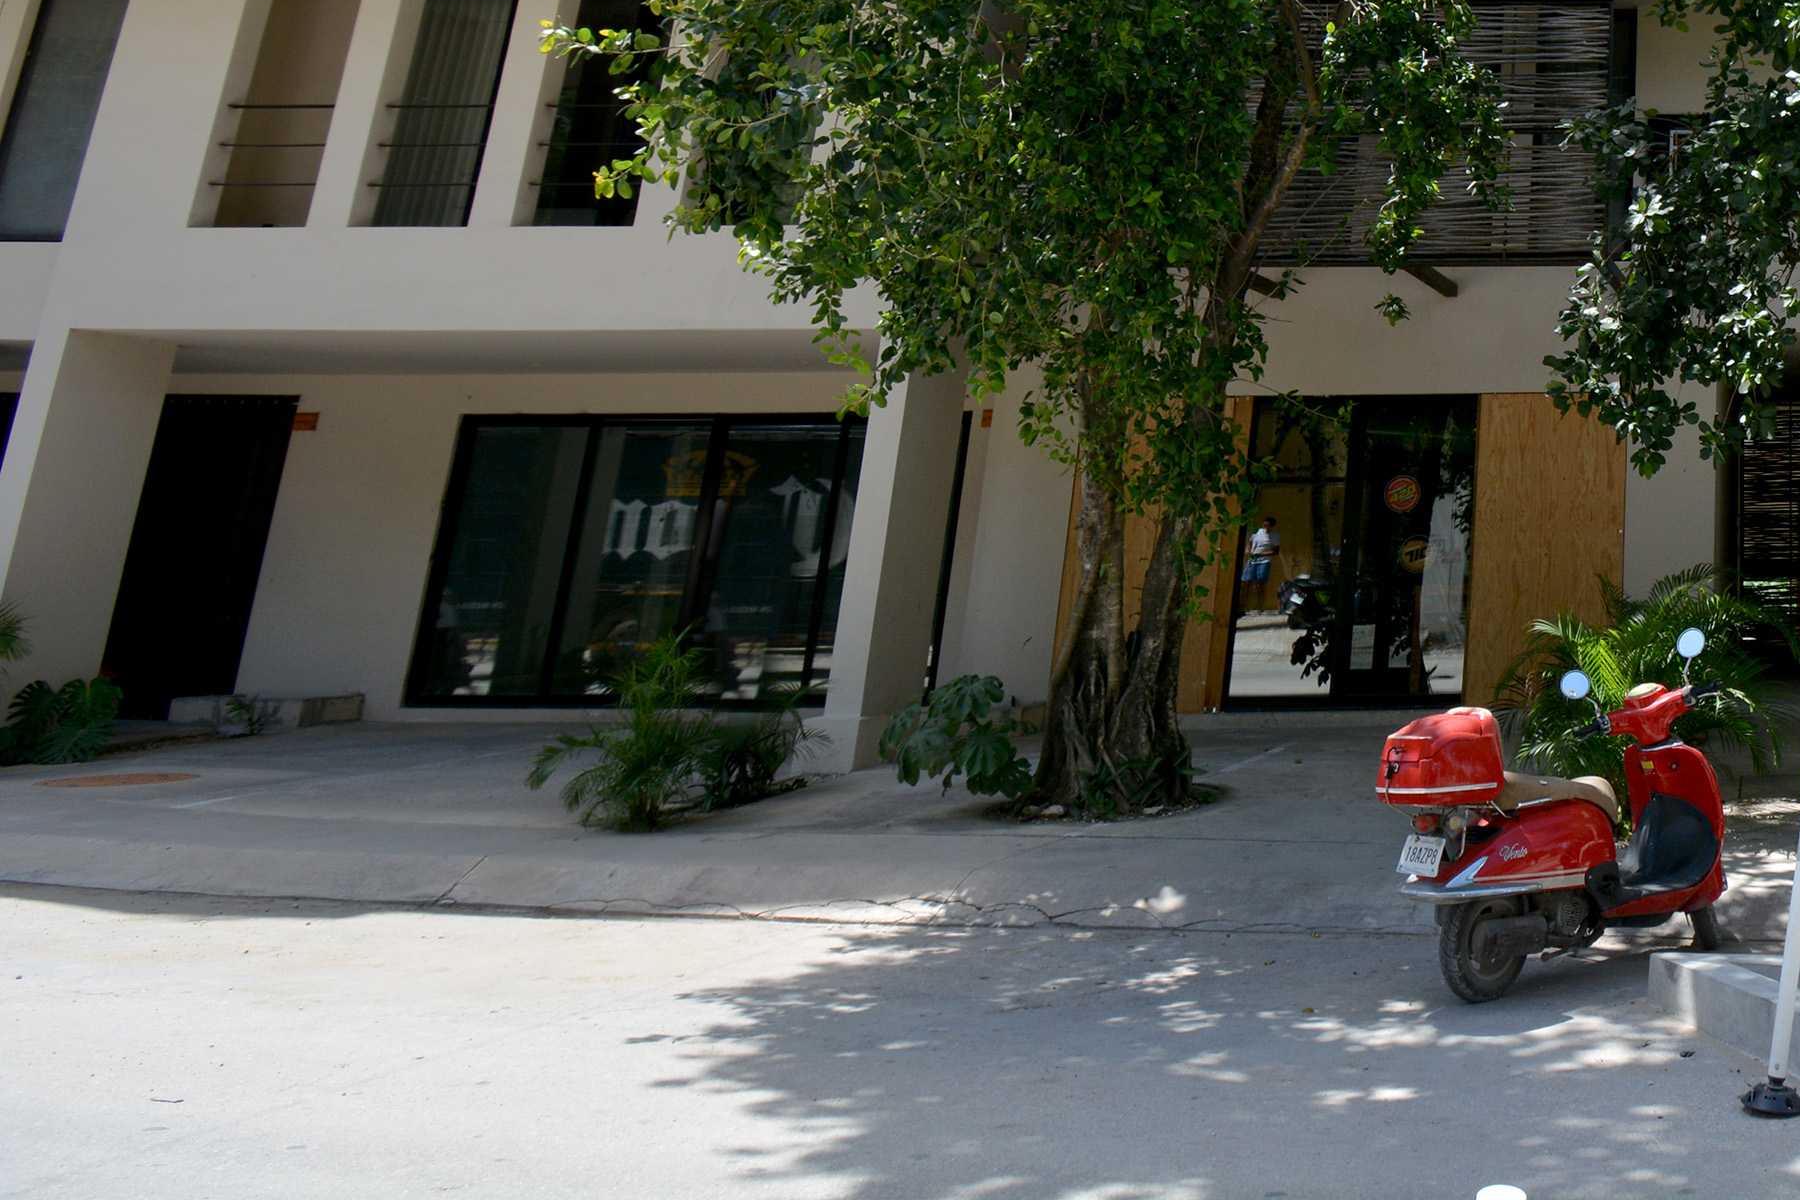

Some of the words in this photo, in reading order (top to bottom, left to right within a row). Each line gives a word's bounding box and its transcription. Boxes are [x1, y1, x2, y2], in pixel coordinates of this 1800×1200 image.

[1390, 484, 1416, 503] 420
[1405, 846, 1438, 865] 18AZP8
[1499, 843, 1529, 862] Vento
